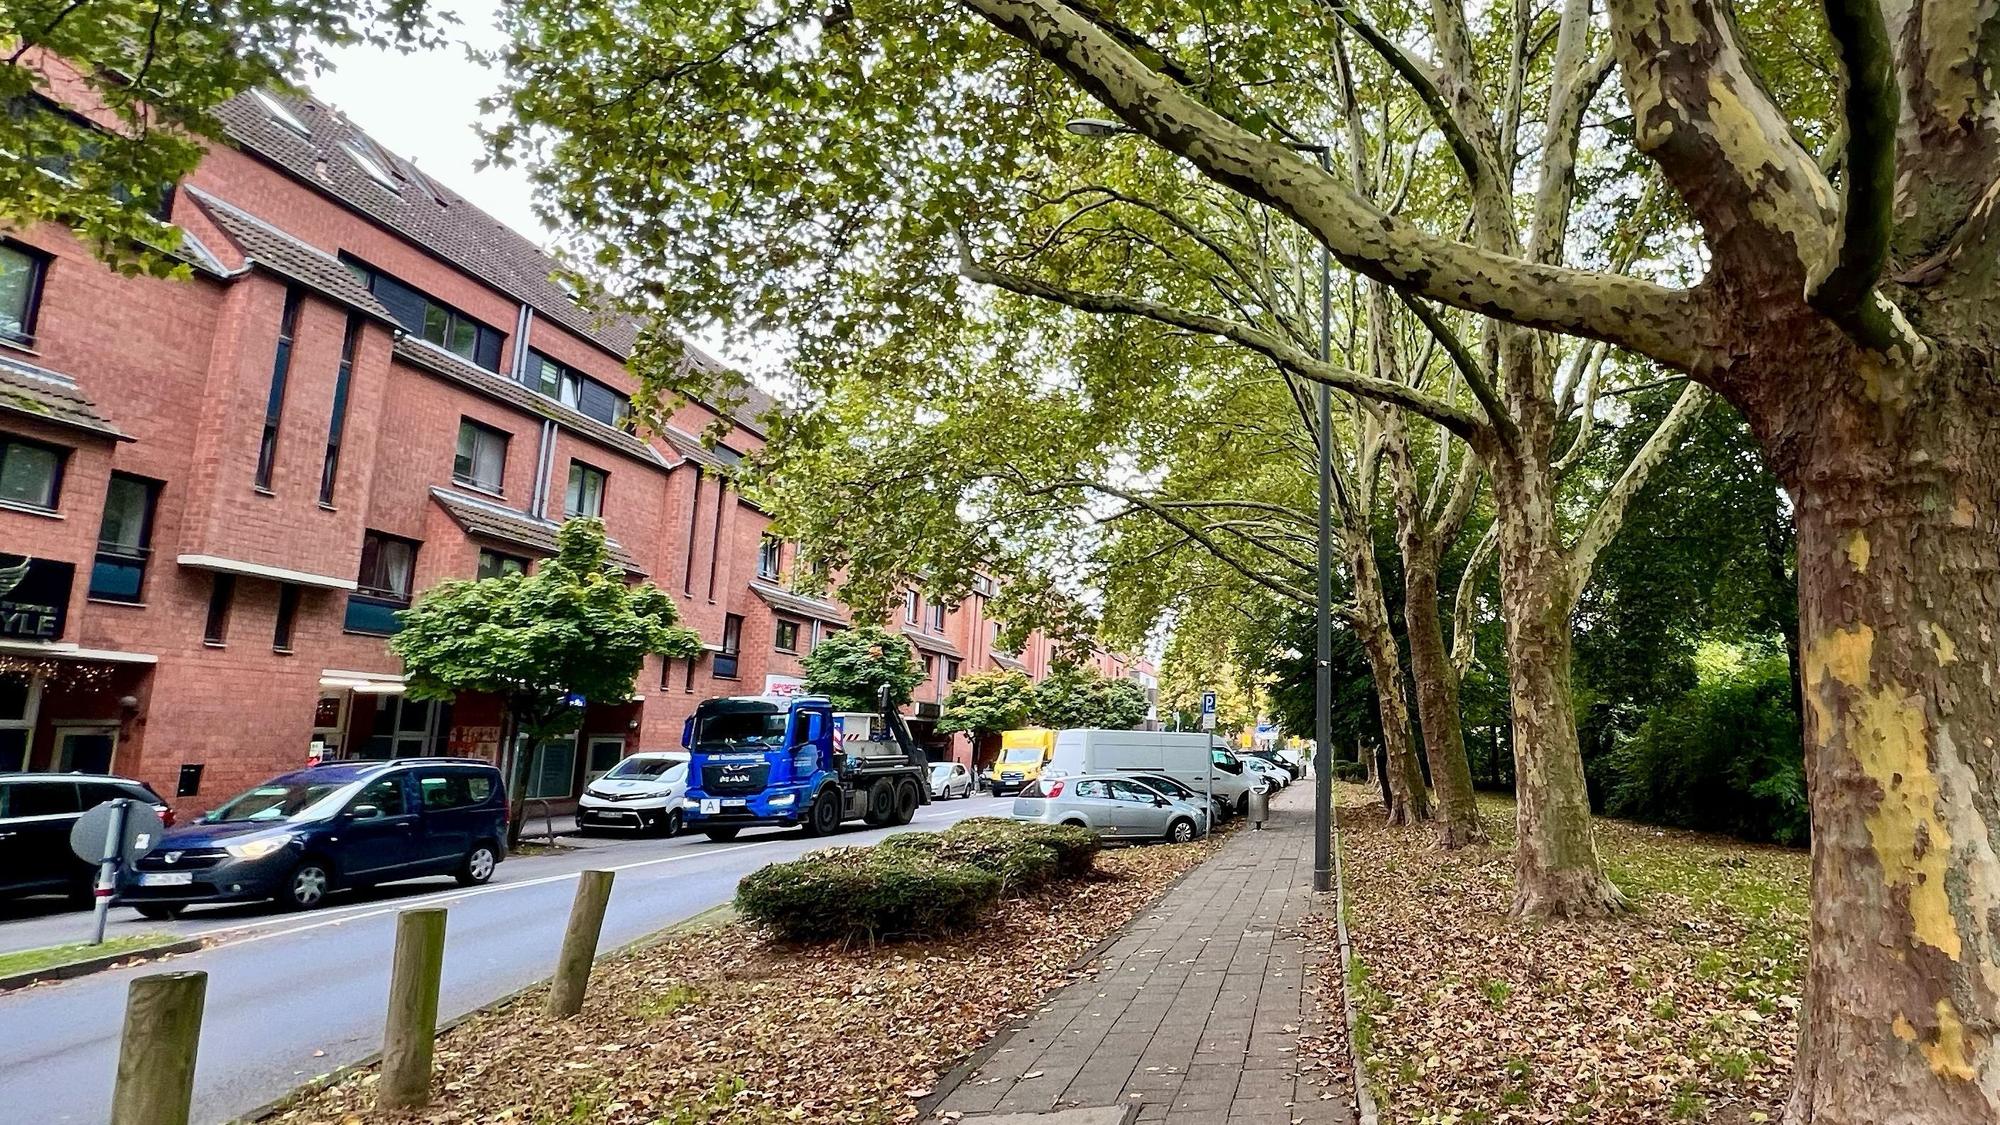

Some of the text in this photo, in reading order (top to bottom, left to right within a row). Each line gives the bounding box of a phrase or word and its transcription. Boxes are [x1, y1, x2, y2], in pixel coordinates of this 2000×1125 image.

[1206, 696, 1214, 712] P
[720, 775, 750, 783] MAN
[706, 801, 715, 811] A
